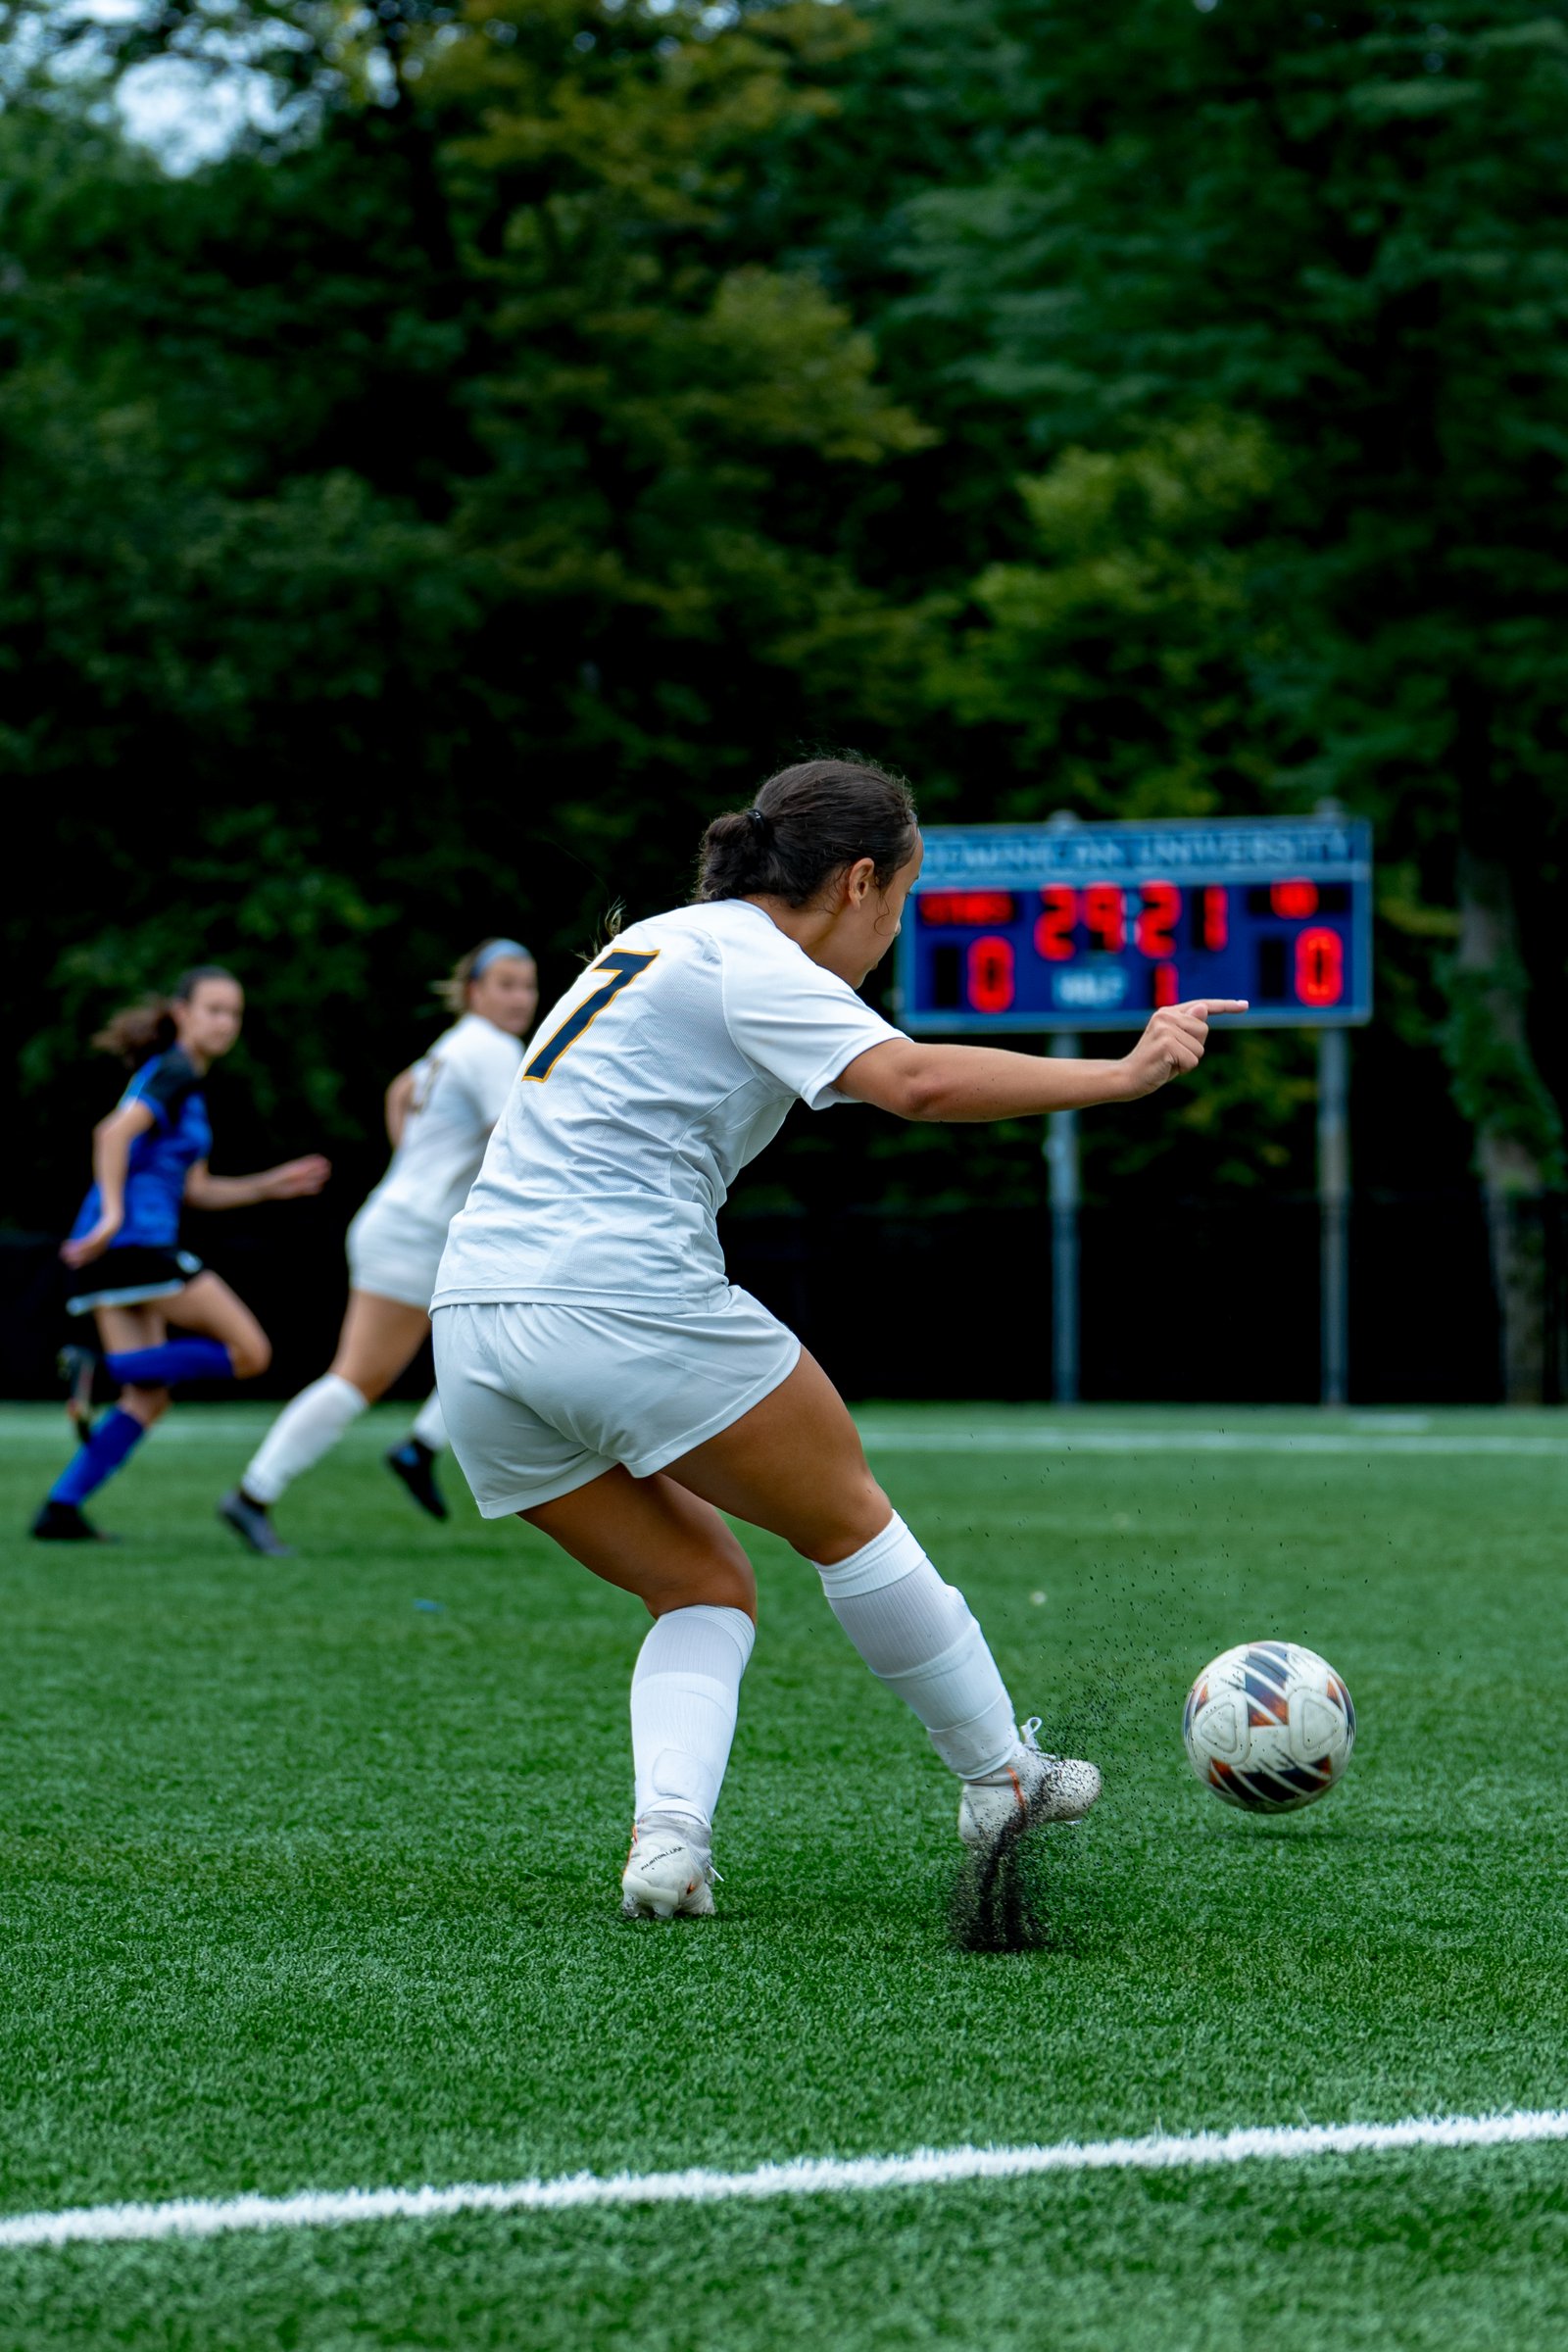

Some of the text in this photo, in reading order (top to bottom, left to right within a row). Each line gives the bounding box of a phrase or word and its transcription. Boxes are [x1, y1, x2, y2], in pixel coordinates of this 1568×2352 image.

[1140, 831, 1349, 863] UNIVERSITY
[967, 936, 1015, 1014] 0
[1295, 926, 1344, 1007] 0
[521, 949, 662, 1083] 7
